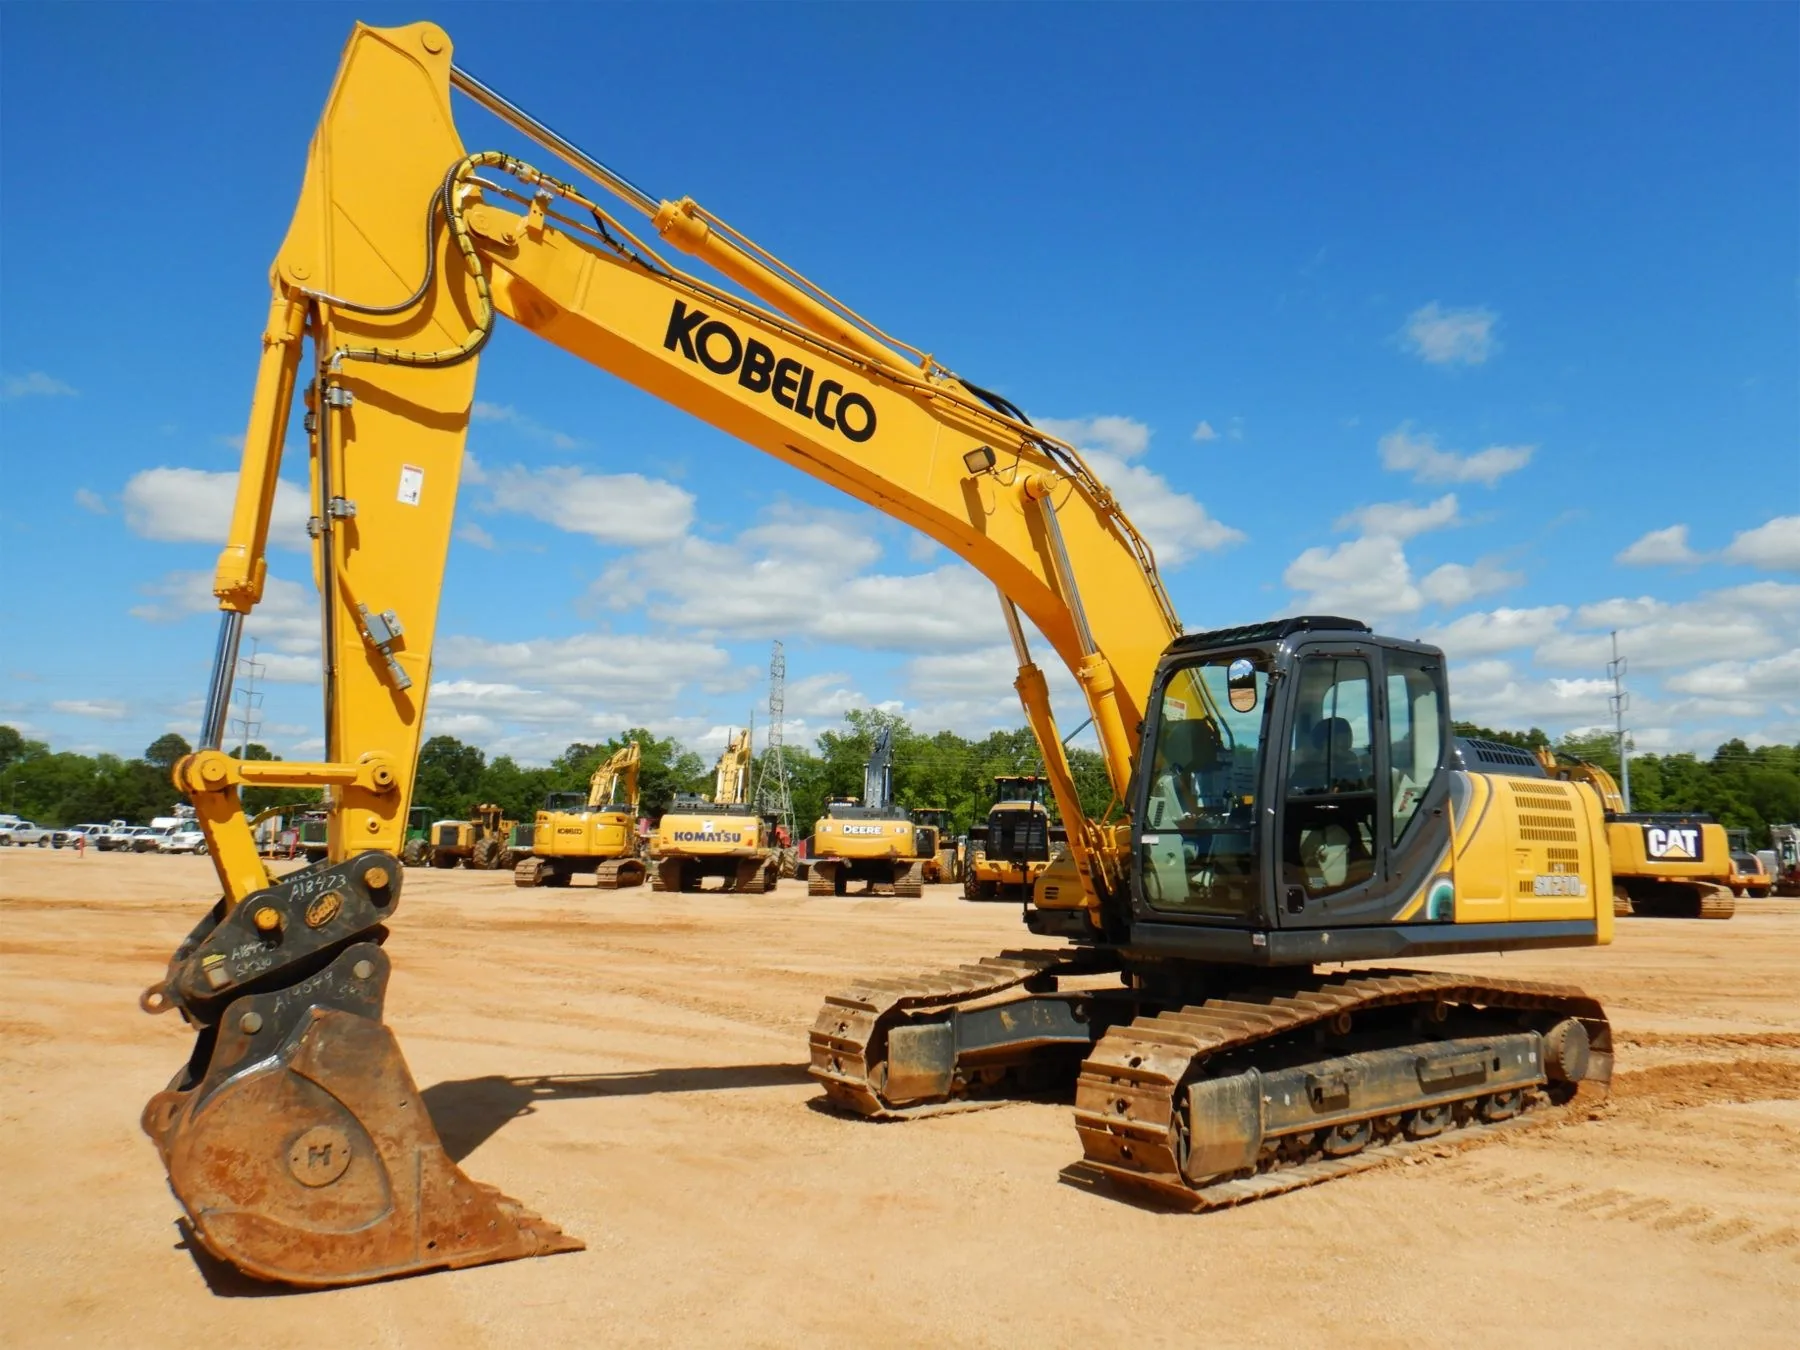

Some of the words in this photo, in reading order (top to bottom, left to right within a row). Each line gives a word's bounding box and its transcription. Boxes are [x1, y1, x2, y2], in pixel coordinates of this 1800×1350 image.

[663, 298, 877, 443] KOBELCO
[674, 830, 742, 843] KOMATSU
[843, 824, 882, 835] DEERE
[1647, 828, 1699, 858] CAT
[288, 874, 347, 903] A18473
[308, 1142, 333, 1169] H
